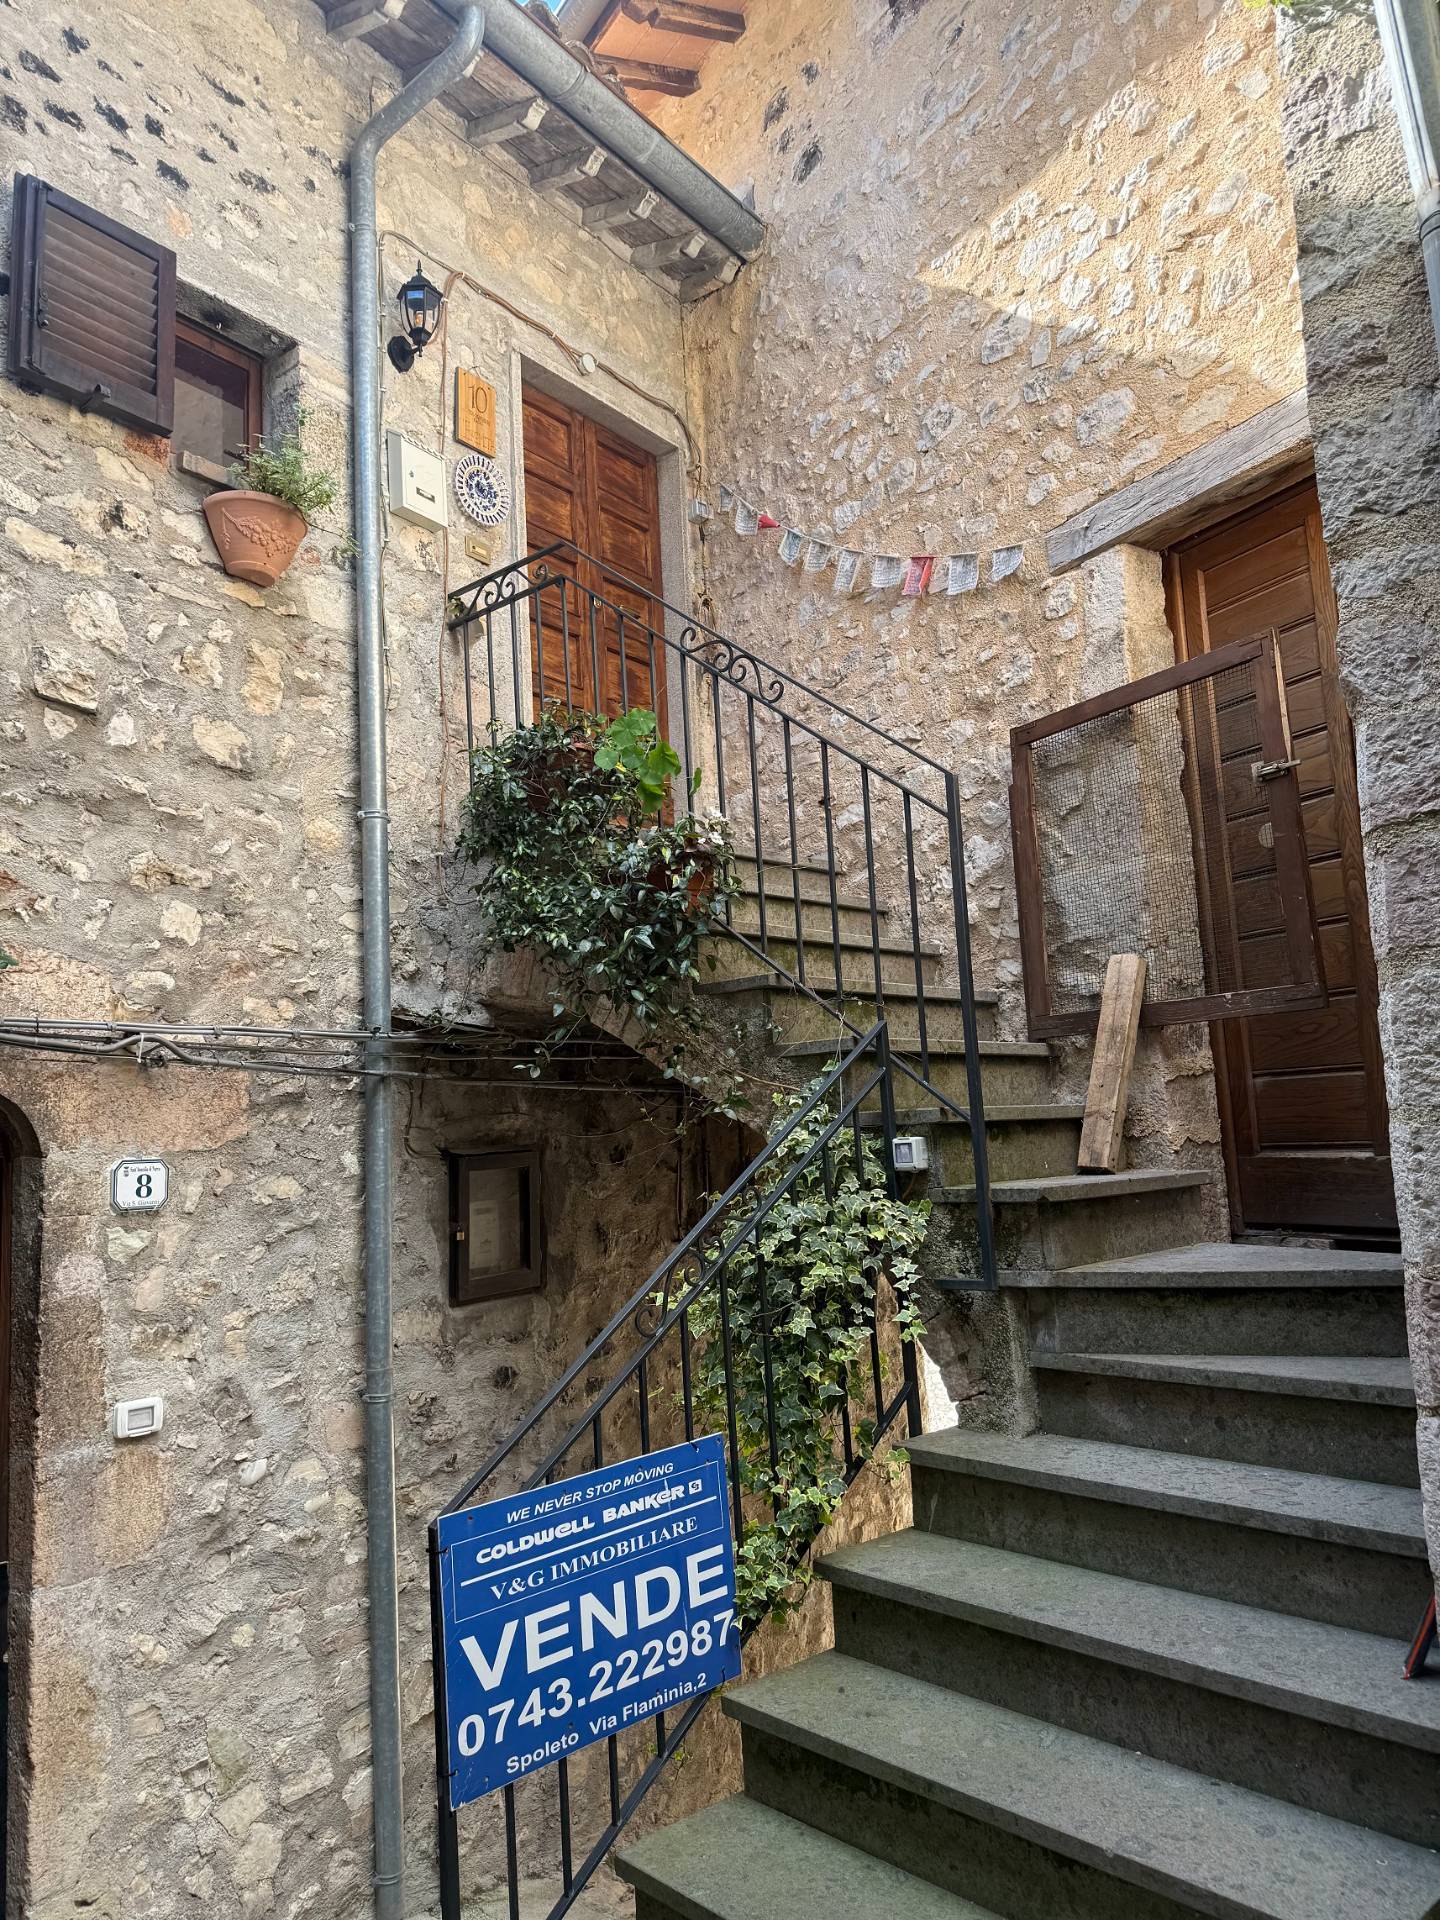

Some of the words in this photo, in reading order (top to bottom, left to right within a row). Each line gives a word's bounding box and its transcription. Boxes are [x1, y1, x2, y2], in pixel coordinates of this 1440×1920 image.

[468, 385, 488, 413] 10
[135, 1173, 153, 1198] 8
[475, 1515, 595, 1565] COLDWELL
[602, 1485, 686, 1524] BANKER
[506, 1505, 531, 1525] WE
[533, 1490, 583, 1518] NEVER
[585, 1477, 622, 1500] STOP
[623, 1462, 675, 1488] MOVING
[490, 1569, 545, 1600] V&G
[549, 1515, 699, 1580] IMMOBILIARE
[459, 1543, 734, 1692] VENDE
[457, 1608, 735, 1758] 0743.222987
[505, 1729, 580, 1776] Spoleto
[588, 1713, 618, 1737] Via
[622, 1672, 708, 1721] Flaminia,2
